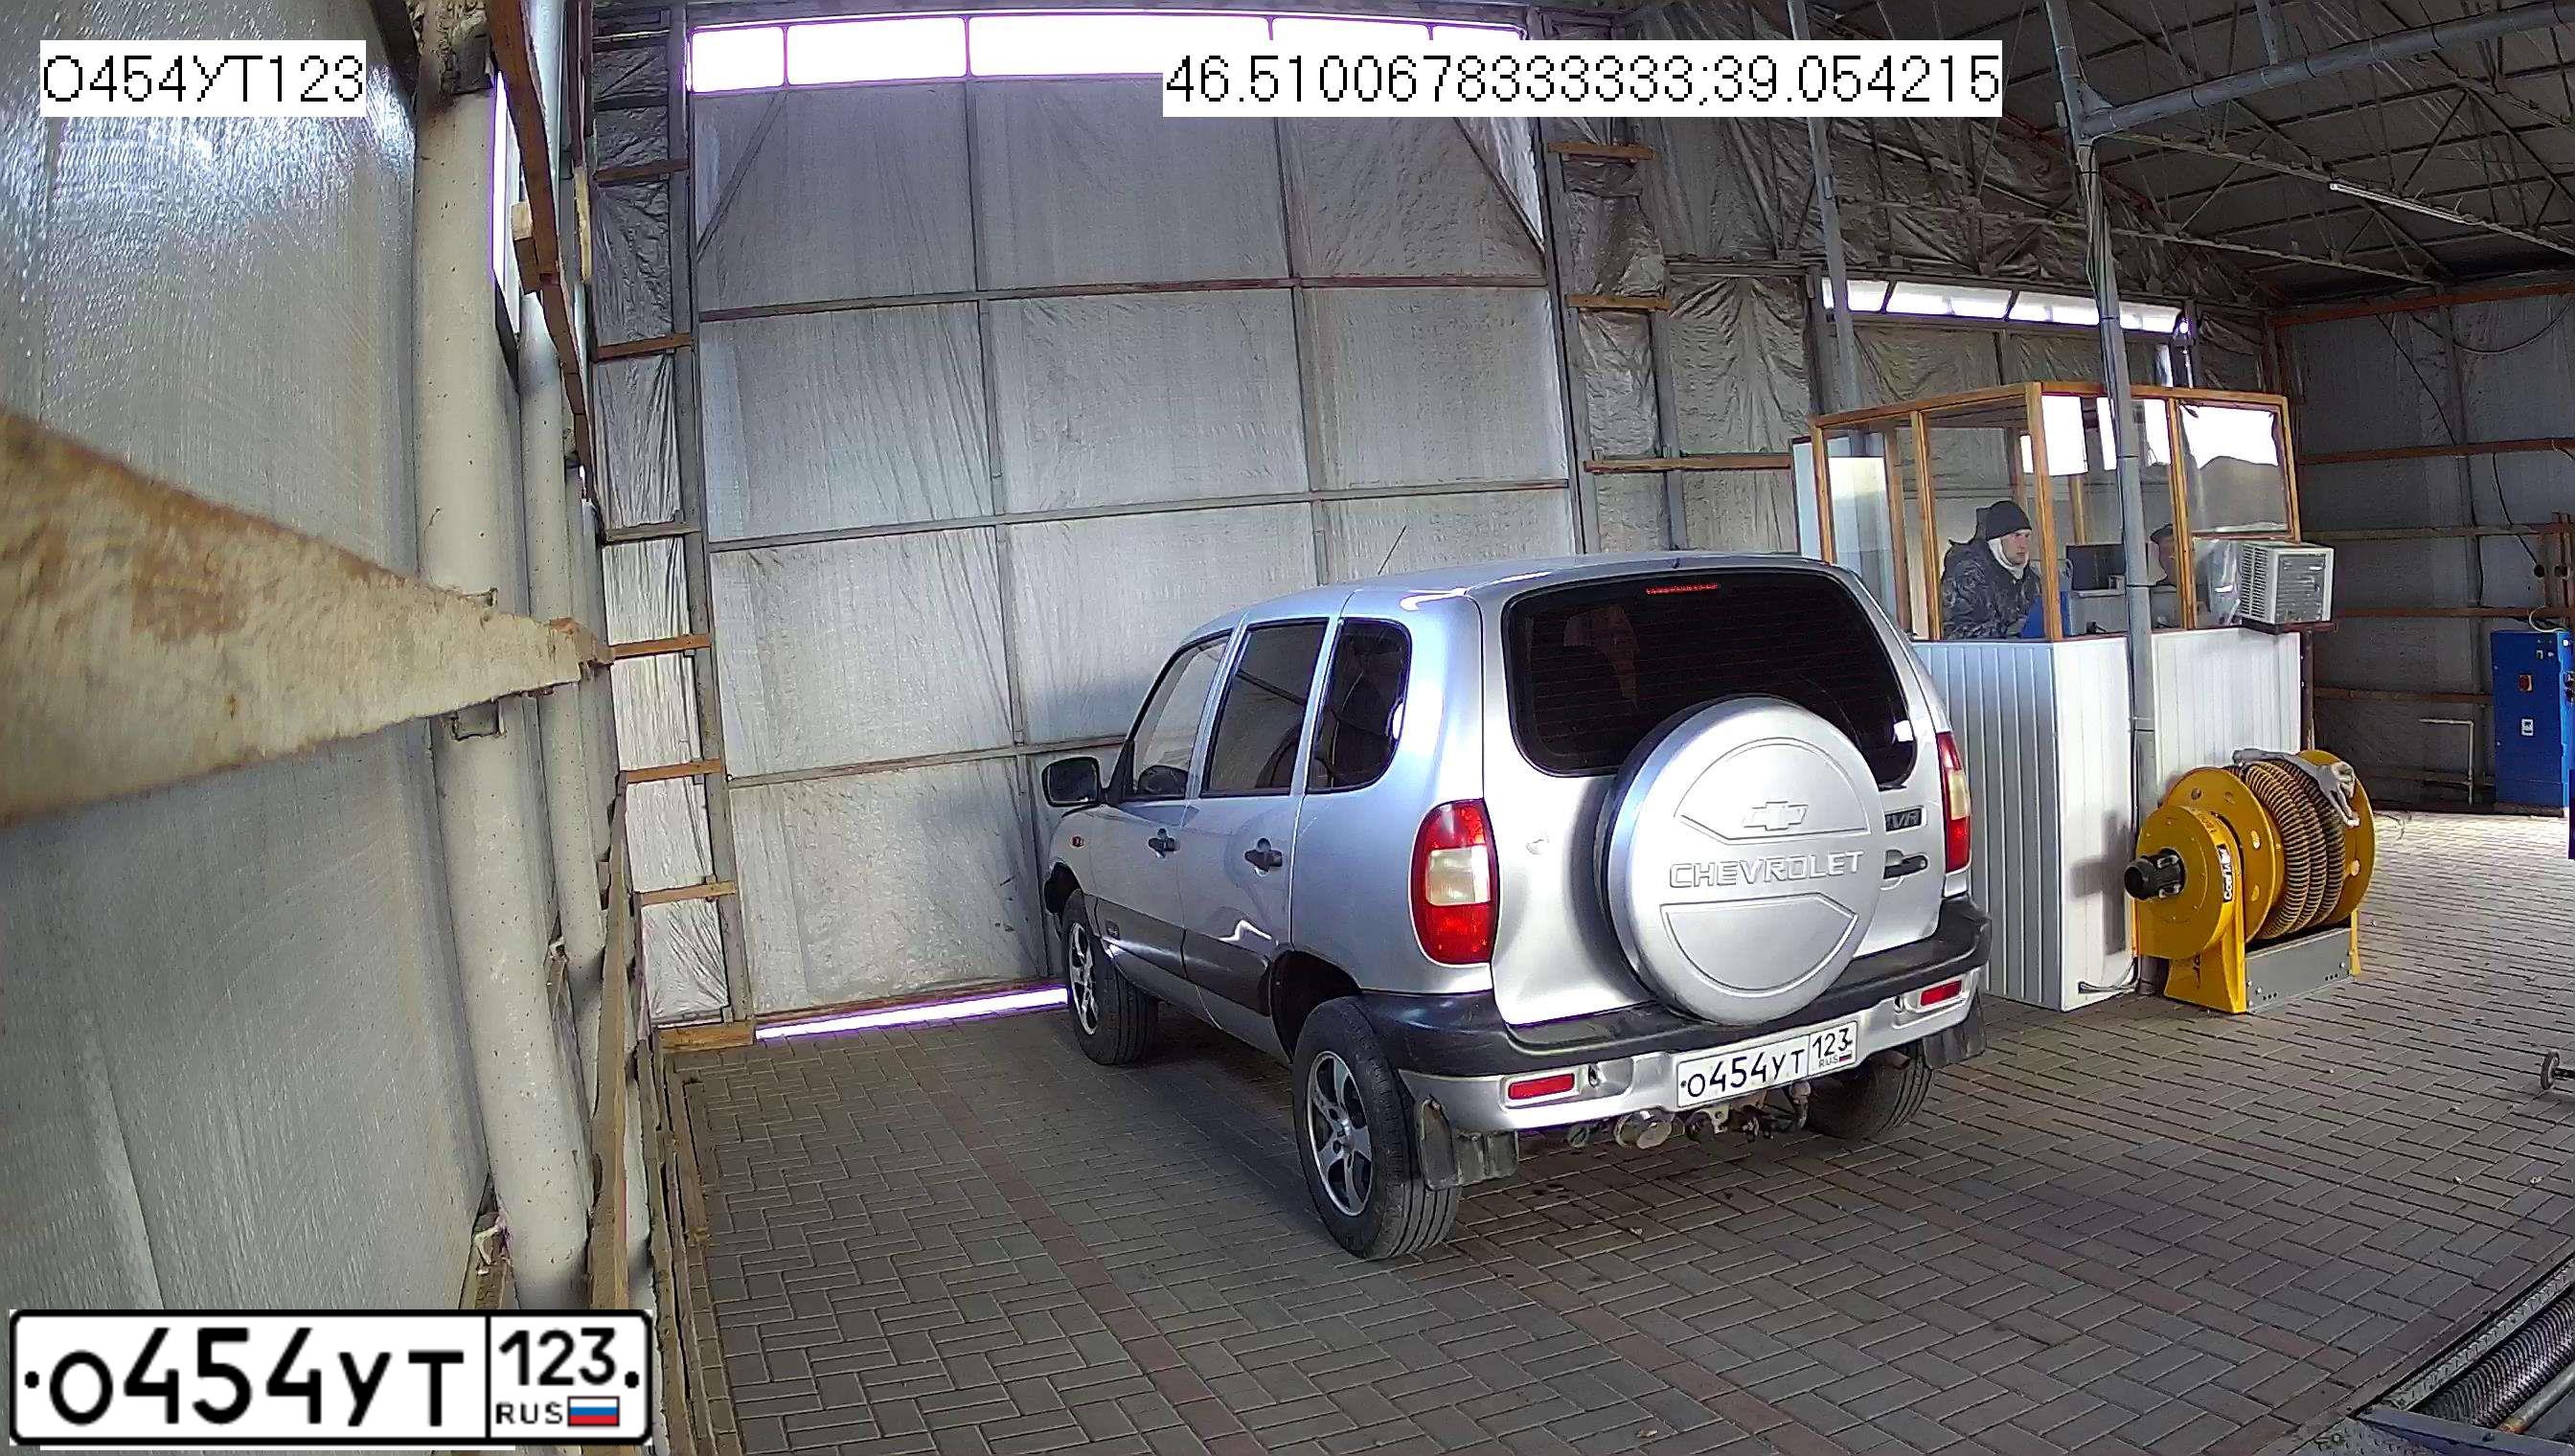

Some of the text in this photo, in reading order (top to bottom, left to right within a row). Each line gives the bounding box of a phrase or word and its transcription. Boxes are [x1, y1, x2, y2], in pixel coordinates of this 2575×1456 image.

[1886, 810, 1920, 830] IVA
[1670, 851, 1864, 888] CHEVROLET
[1812, 1028, 1851, 1058] 123
[1819, 1057, 1838, 1068] RUS
